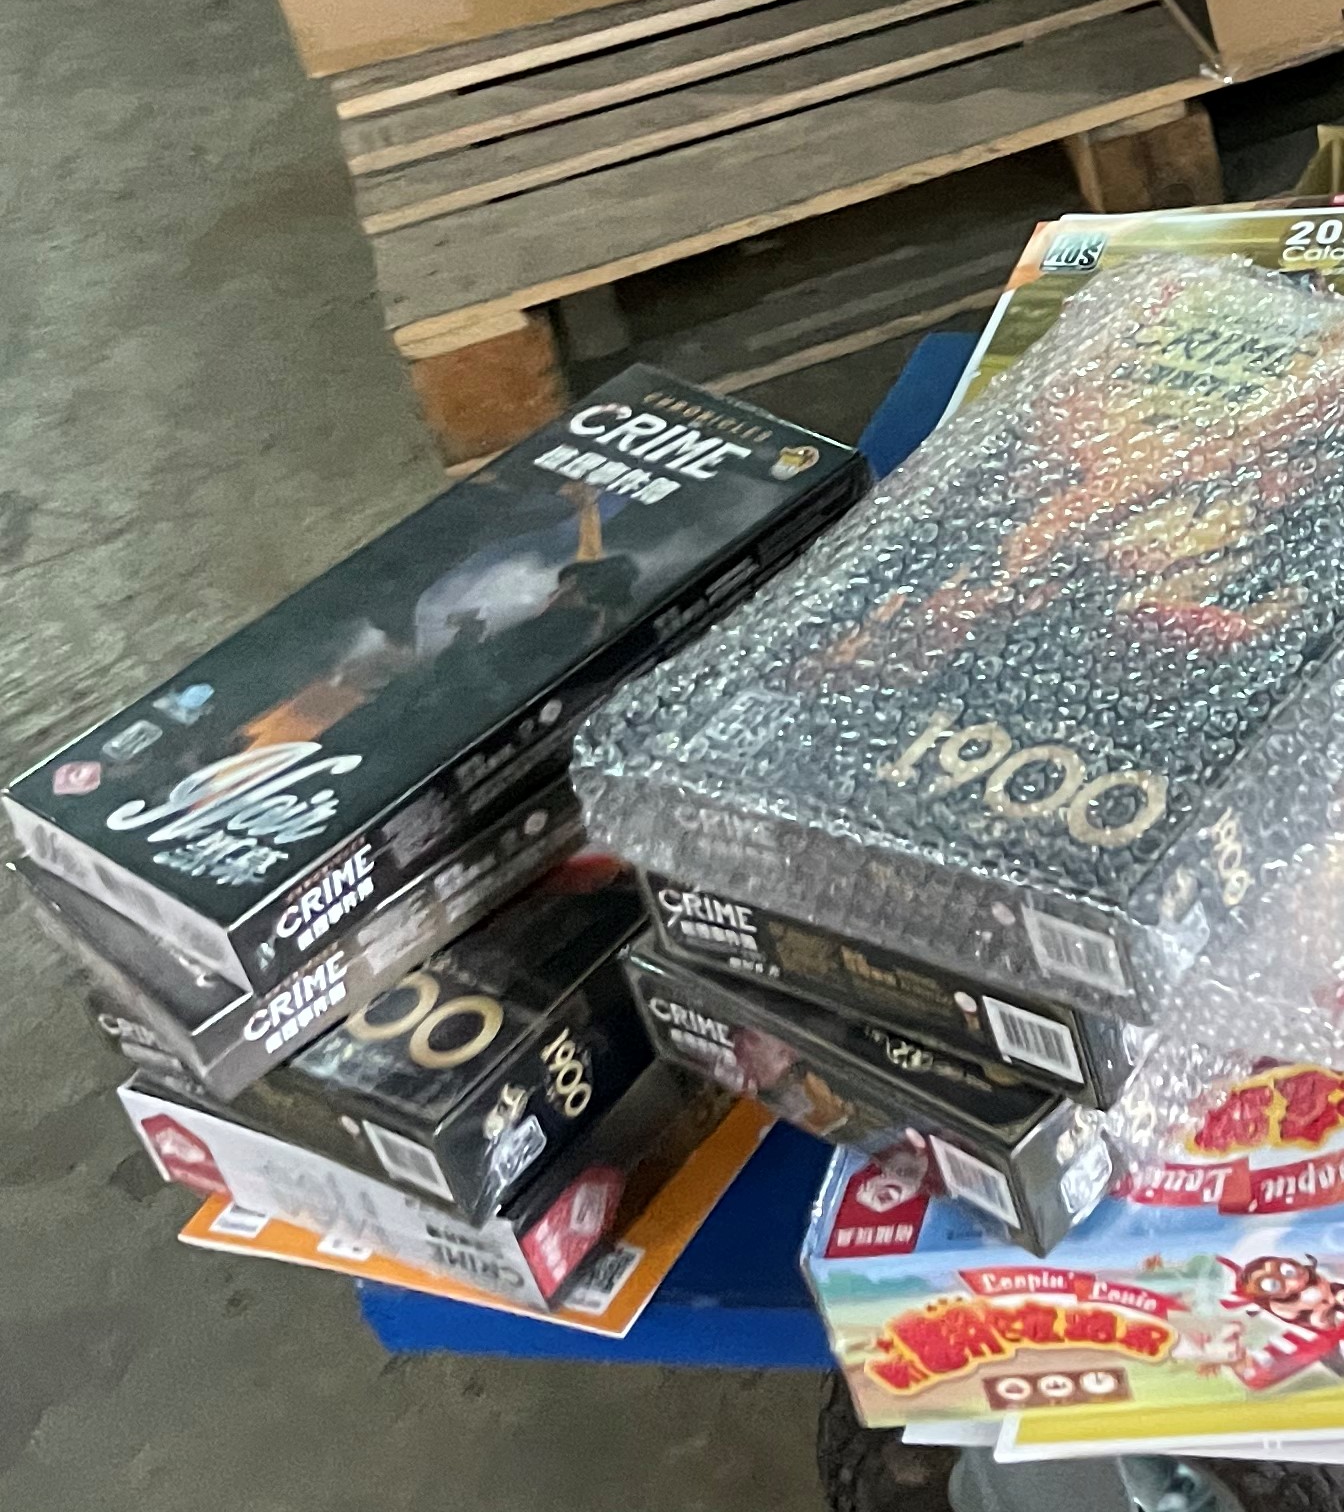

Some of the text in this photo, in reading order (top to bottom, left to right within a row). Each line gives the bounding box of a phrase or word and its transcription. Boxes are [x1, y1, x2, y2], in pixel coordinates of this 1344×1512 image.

[569, 403, 752, 480] CRIME
[276, 844, 376, 940] CRIME
[658, 888, 758, 935] CRIME
[244, 950, 349, 1042] CRIME
